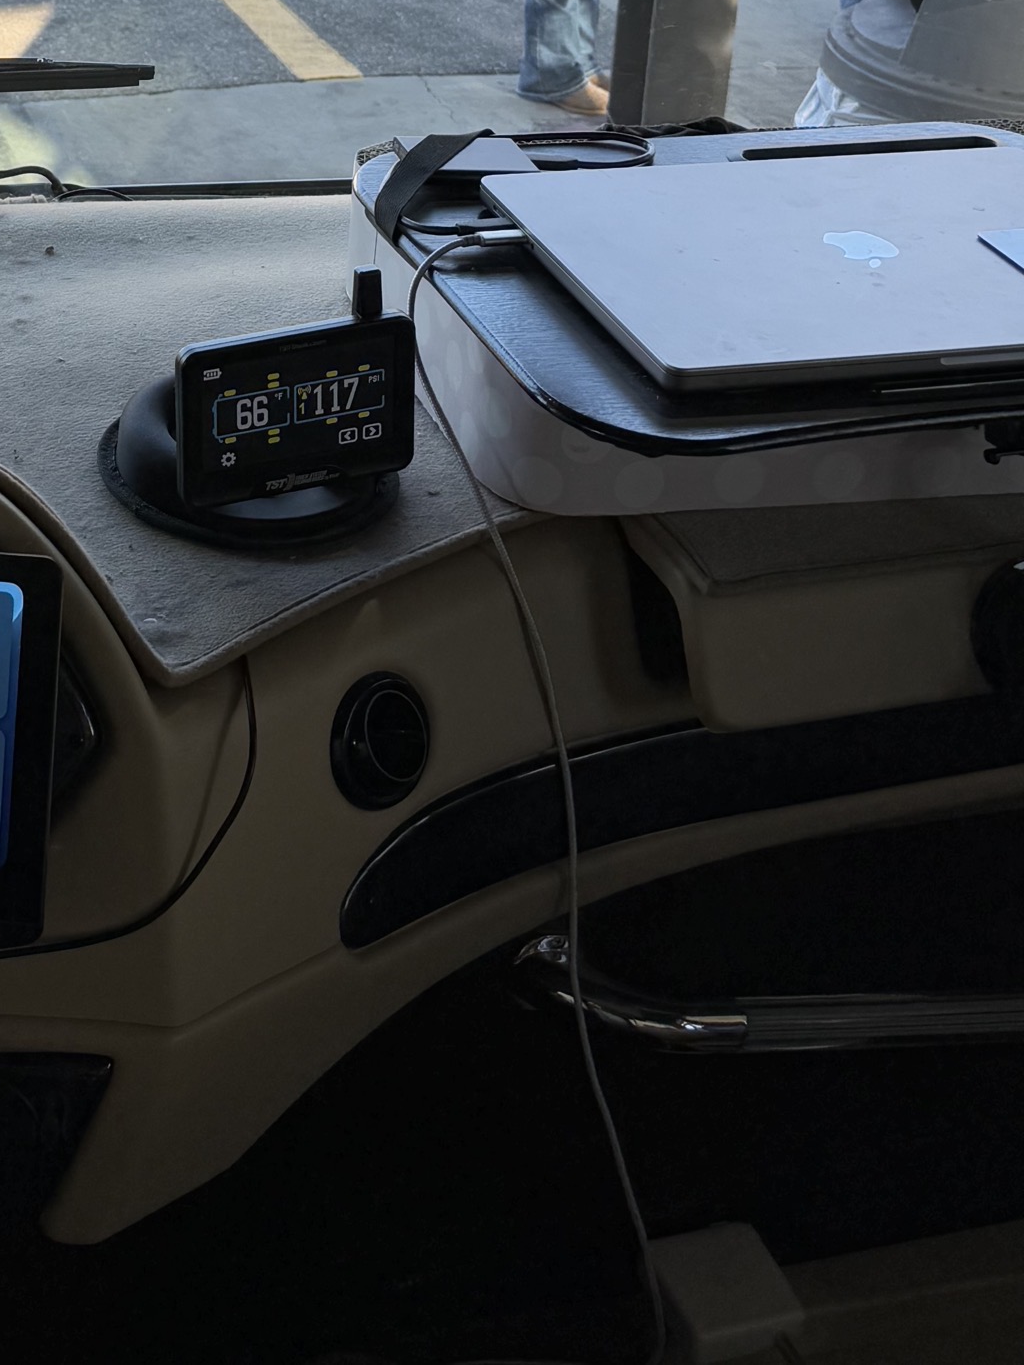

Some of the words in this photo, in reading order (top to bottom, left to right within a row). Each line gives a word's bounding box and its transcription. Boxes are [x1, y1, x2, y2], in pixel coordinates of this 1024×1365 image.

[236, 395, 269, 431] 66
[314, 377, 359, 415] 117
[368, 375, 380, 384] PSI
[265, 478, 288, 491] TST
